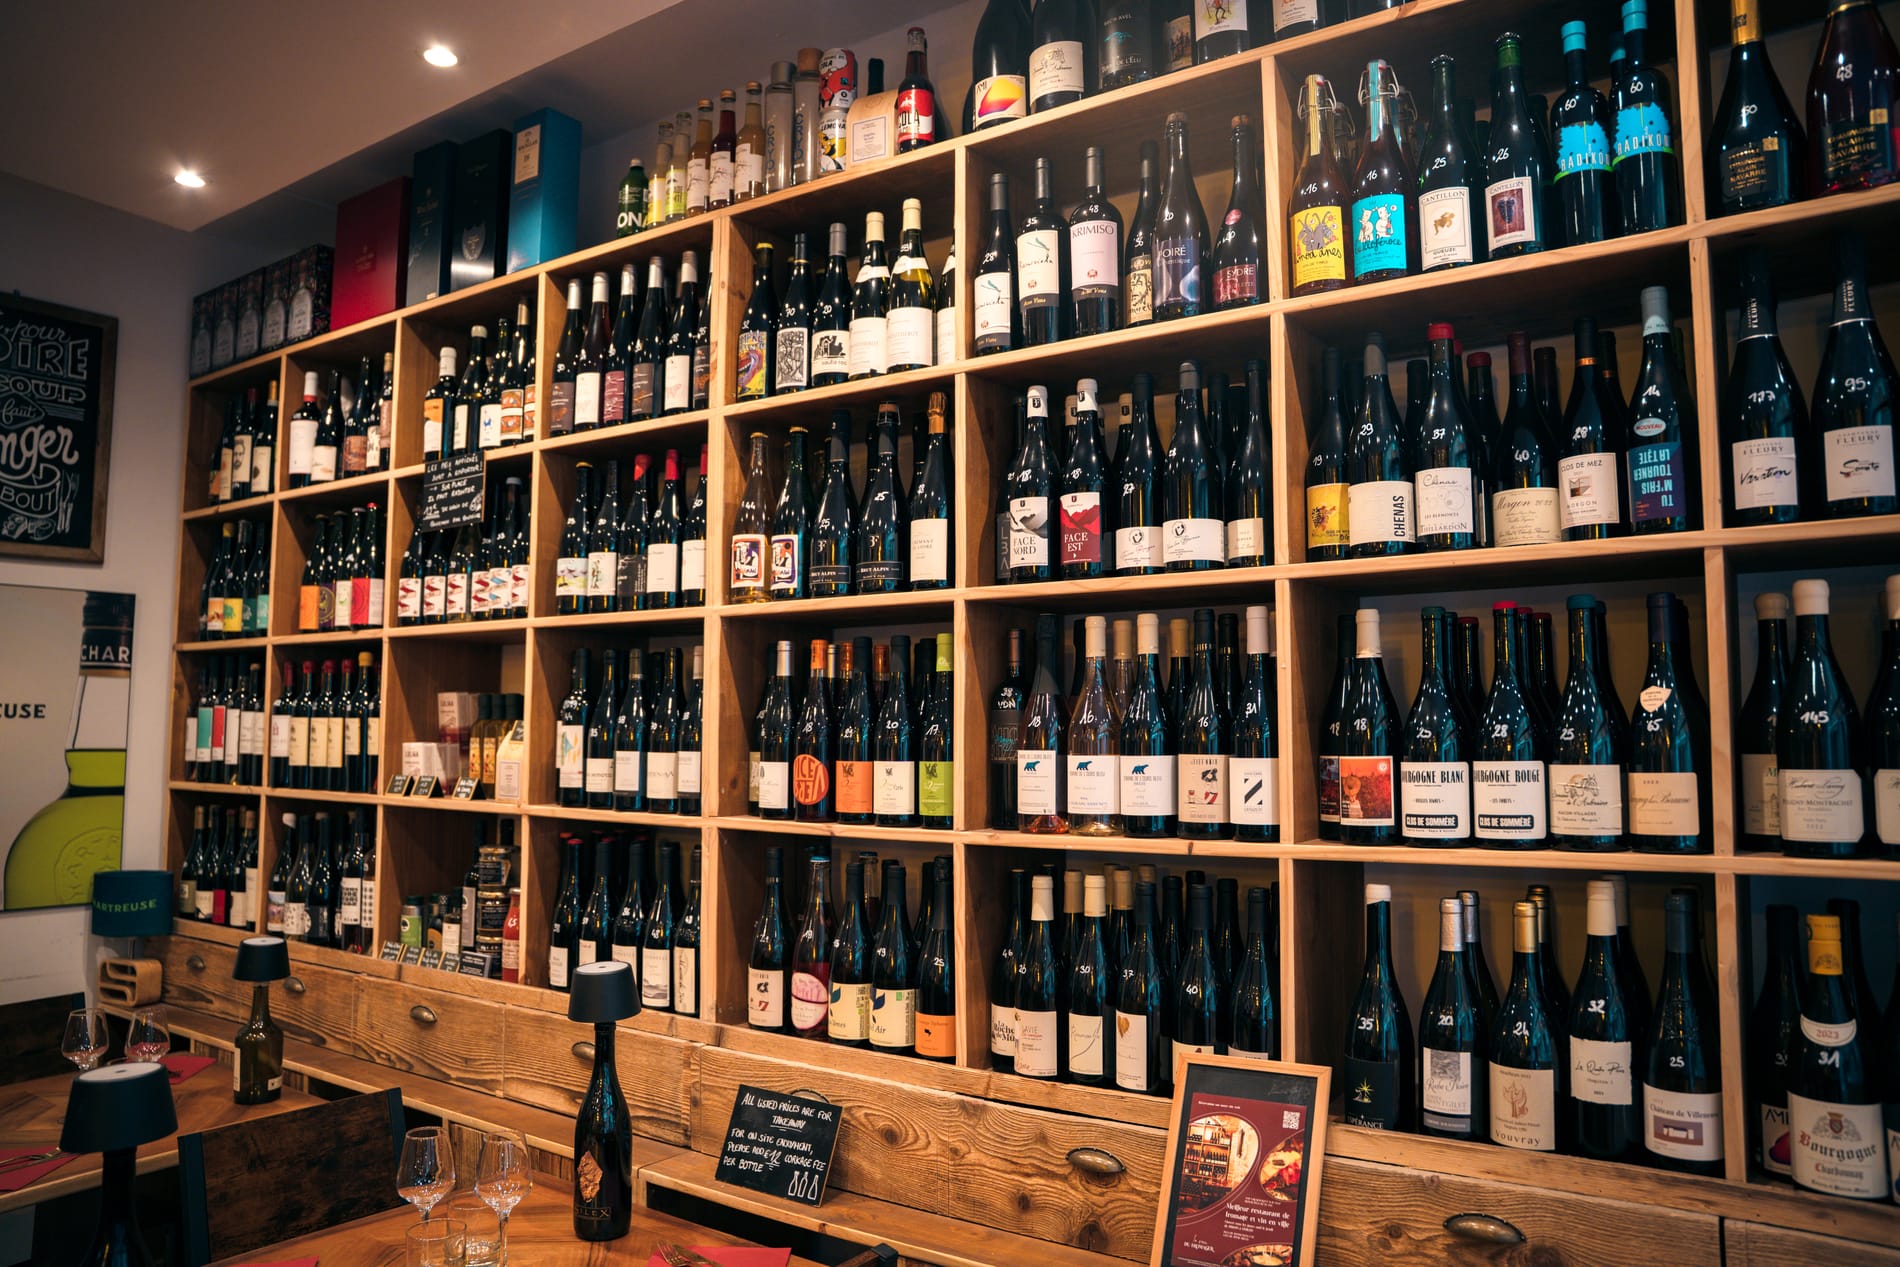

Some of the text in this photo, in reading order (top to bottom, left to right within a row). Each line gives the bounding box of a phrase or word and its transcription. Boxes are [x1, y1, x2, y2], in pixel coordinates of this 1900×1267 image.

[1629, 81, 1643, 93] 60
[1564, 98, 1577, 111] 60
[1616, 134, 1670, 154] RADIKON
[1432, 156, 1447, 170] 25
[1560, 153, 1610, 172] RADIKON
[1367, 169, 1378, 181] 16
[1088, 204, 1099, 213] 48
[1072, 224, 1114, 239] KRIMISO
[1844, 376, 1867, 392] 95
[1359, 423, 1374, 437] 29
[1836, 434, 1881, 445] FLEURY
[1514, 450, 1530, 462] 40
[1743, 445, 1784, 456] FLEURY
[1576, 461, 1585, 470] DE
[1587, 459, 1603, 468] MEZ
[1, 485, 58, 512] BOUT
[1392, 495, 1405, 537] CHENAS
[1064, 532, 1089, 543] FACE
[1067, 543, 1084, 553] EST
[885, 720, 899, 729] 20
[1799, 711, 1830, 724] 145
[1491, 724, 1508, 739] 28
[1559, 728, 1575, 740] 25
[1441, 770, 1465, 784] BLANC
[1515, 769, 1539, 783] ROUGE
[1185, 985, 1199, 994] 40
[1357, 1017, 1374, 1030] 35
[1669, 1056, 1685, 1068] 25
[1818, 1051, 1841, 1068] 31
[741, 1092, 755, 1106] ALL
[778, 1100, 800, 1113] PRICES
[801, 1106, 816, 1117] ARE
[818, 1110, 832, 1122] FOR
[772, 1115, 807, 1129] TAKEAWAY
[731, 1128, 745, 1138] FOR
[747, 1132, 757, 1140] ON
[758, 1133, 775, 1144] SITE
[1495, 1128, 1541, 1146] Vouvray
[1800, 1130, 1878, 1163] Bourgogne
[727, 1141, 750, 1153] PLEASE
[751, 1145, 763, 1155] ADD
[784, 1153, 813, 1168] CORKAGE
[812, 1159, 828, 1171] FEE
[723, 1155, 766, 1173] PER BOTTLE
[1250, 1207, 1281, 1218] restaurant
[1282, 1211, 1290, 1219] de
[1257, 1216, 1267, 1225] vin
